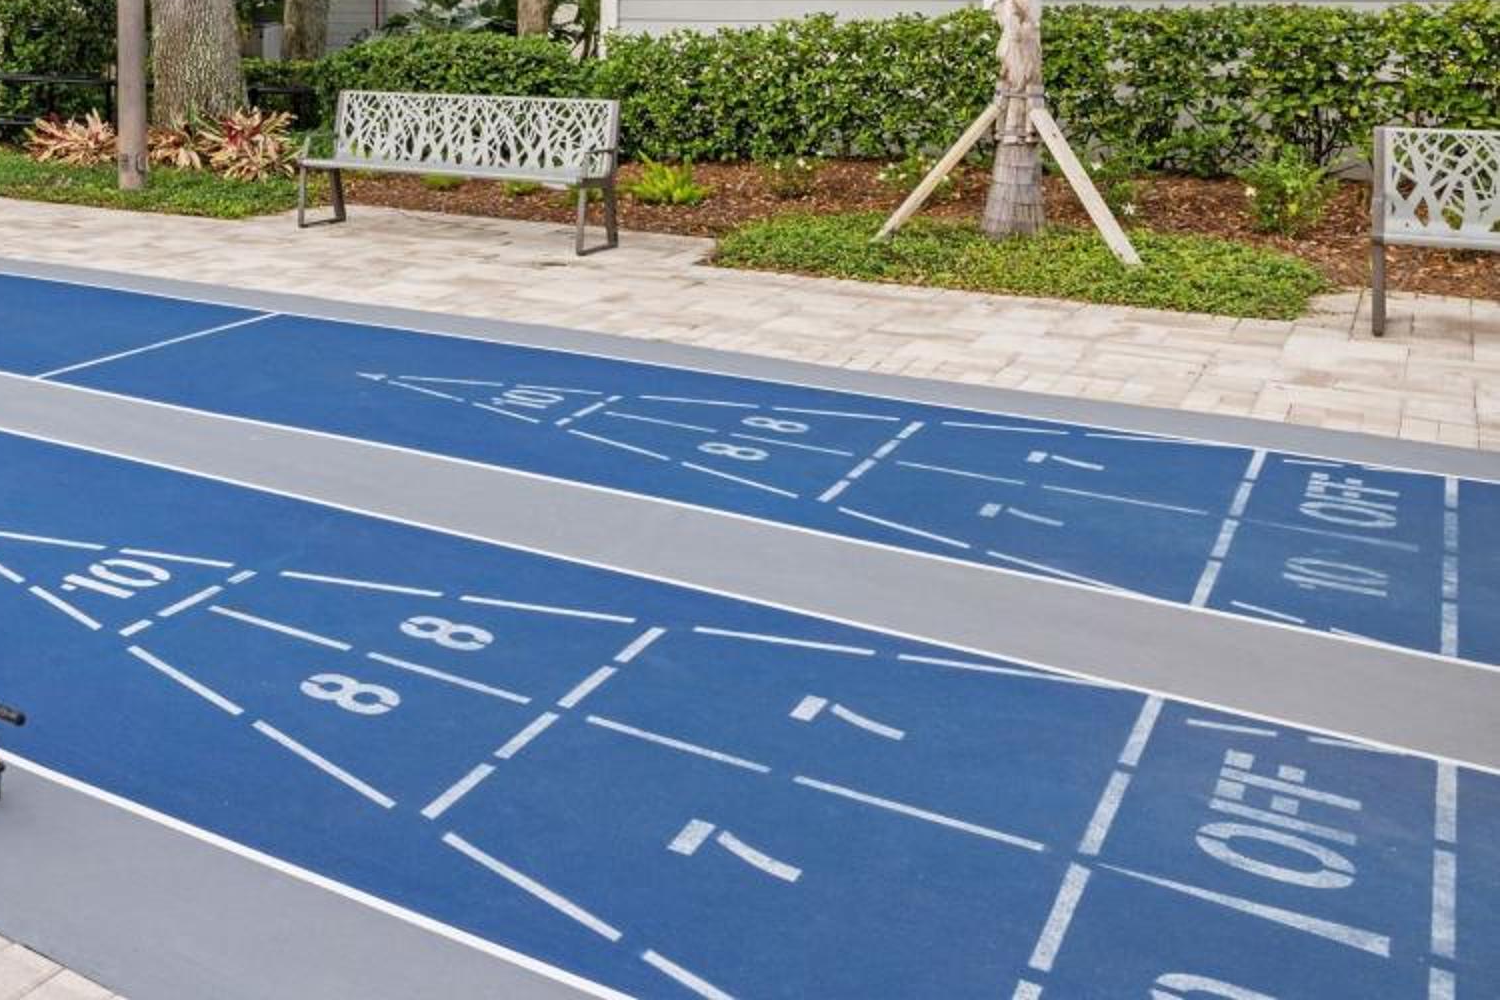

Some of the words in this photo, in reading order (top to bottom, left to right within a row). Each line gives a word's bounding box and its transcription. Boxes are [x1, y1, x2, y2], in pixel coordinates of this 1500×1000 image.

[491, 389, 564, 409] 10
[740, 415, 809, 433] 8
[697, 441, 769, 461] 8
[1025, 451, 1104, 471] 7
[978, 503, 1064, 527] 7
[1300, 472, 1400, 528] OFF
[60, 558, 171, 599] 10
[1283, 556, 1389, 597] 10
[399, 615, 494, 651] 8
[299, 672, 401, 715] 8
[788, 695, 906, 741] 7
[1195, 748, 1362, 889] OFF
[666, 818, 803, 883] 7
